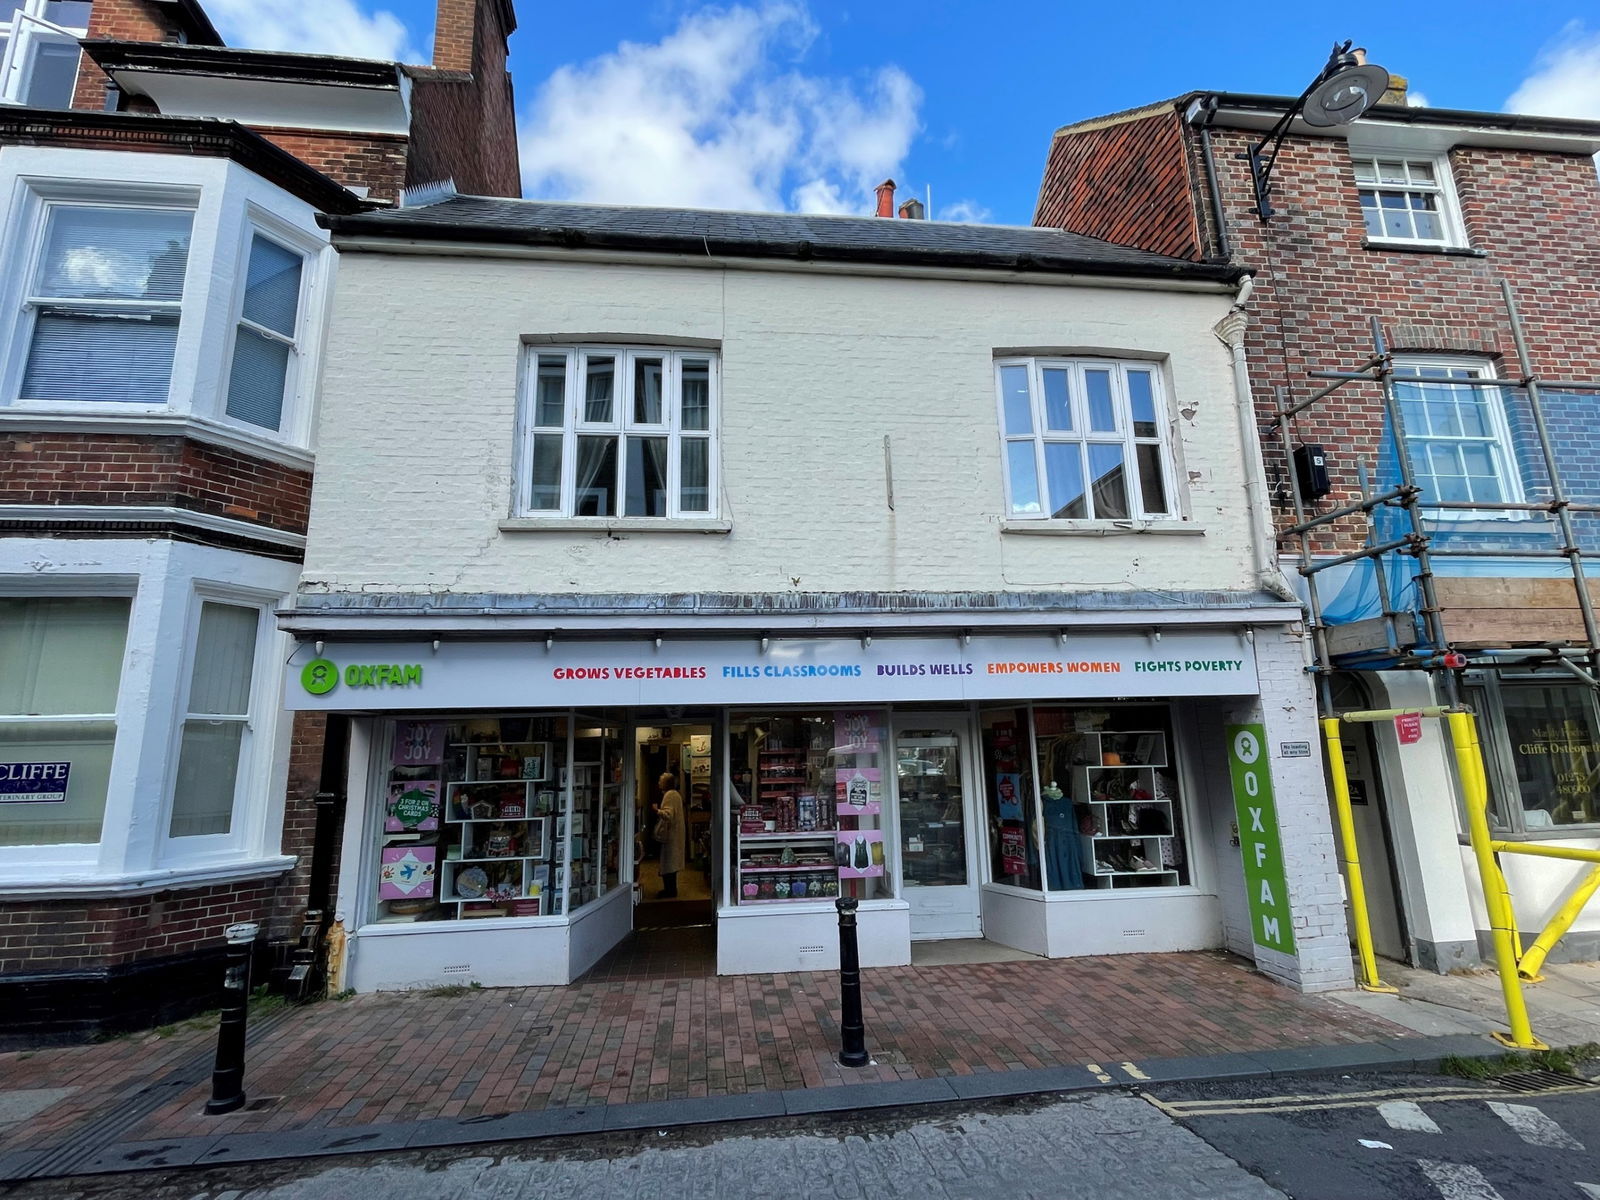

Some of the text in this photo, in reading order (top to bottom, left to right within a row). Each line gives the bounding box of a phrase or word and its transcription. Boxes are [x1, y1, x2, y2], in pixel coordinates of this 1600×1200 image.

[553, 666, 706, 680] GROWS VEGETABLES
[722, 665, 862, 678] FILLS CLASSROOMS
[876, 663, 973, 677] BUILDS WELLS
[987, 662, 1121, 674] EMPOWERS WOMEN
[1134, 660, 1243, 673] FIGHTS POVERTY
[345, 664, 422, 687] OXFAM
[406, 727, 434, 741] JOY
[404, 745, 432, 760] JOY
[1520, 744, 1548, 755] Cliffe
[0, 764, 67, 780] CLIFFE
[1244, 771, 1281, 945] OXFAM
